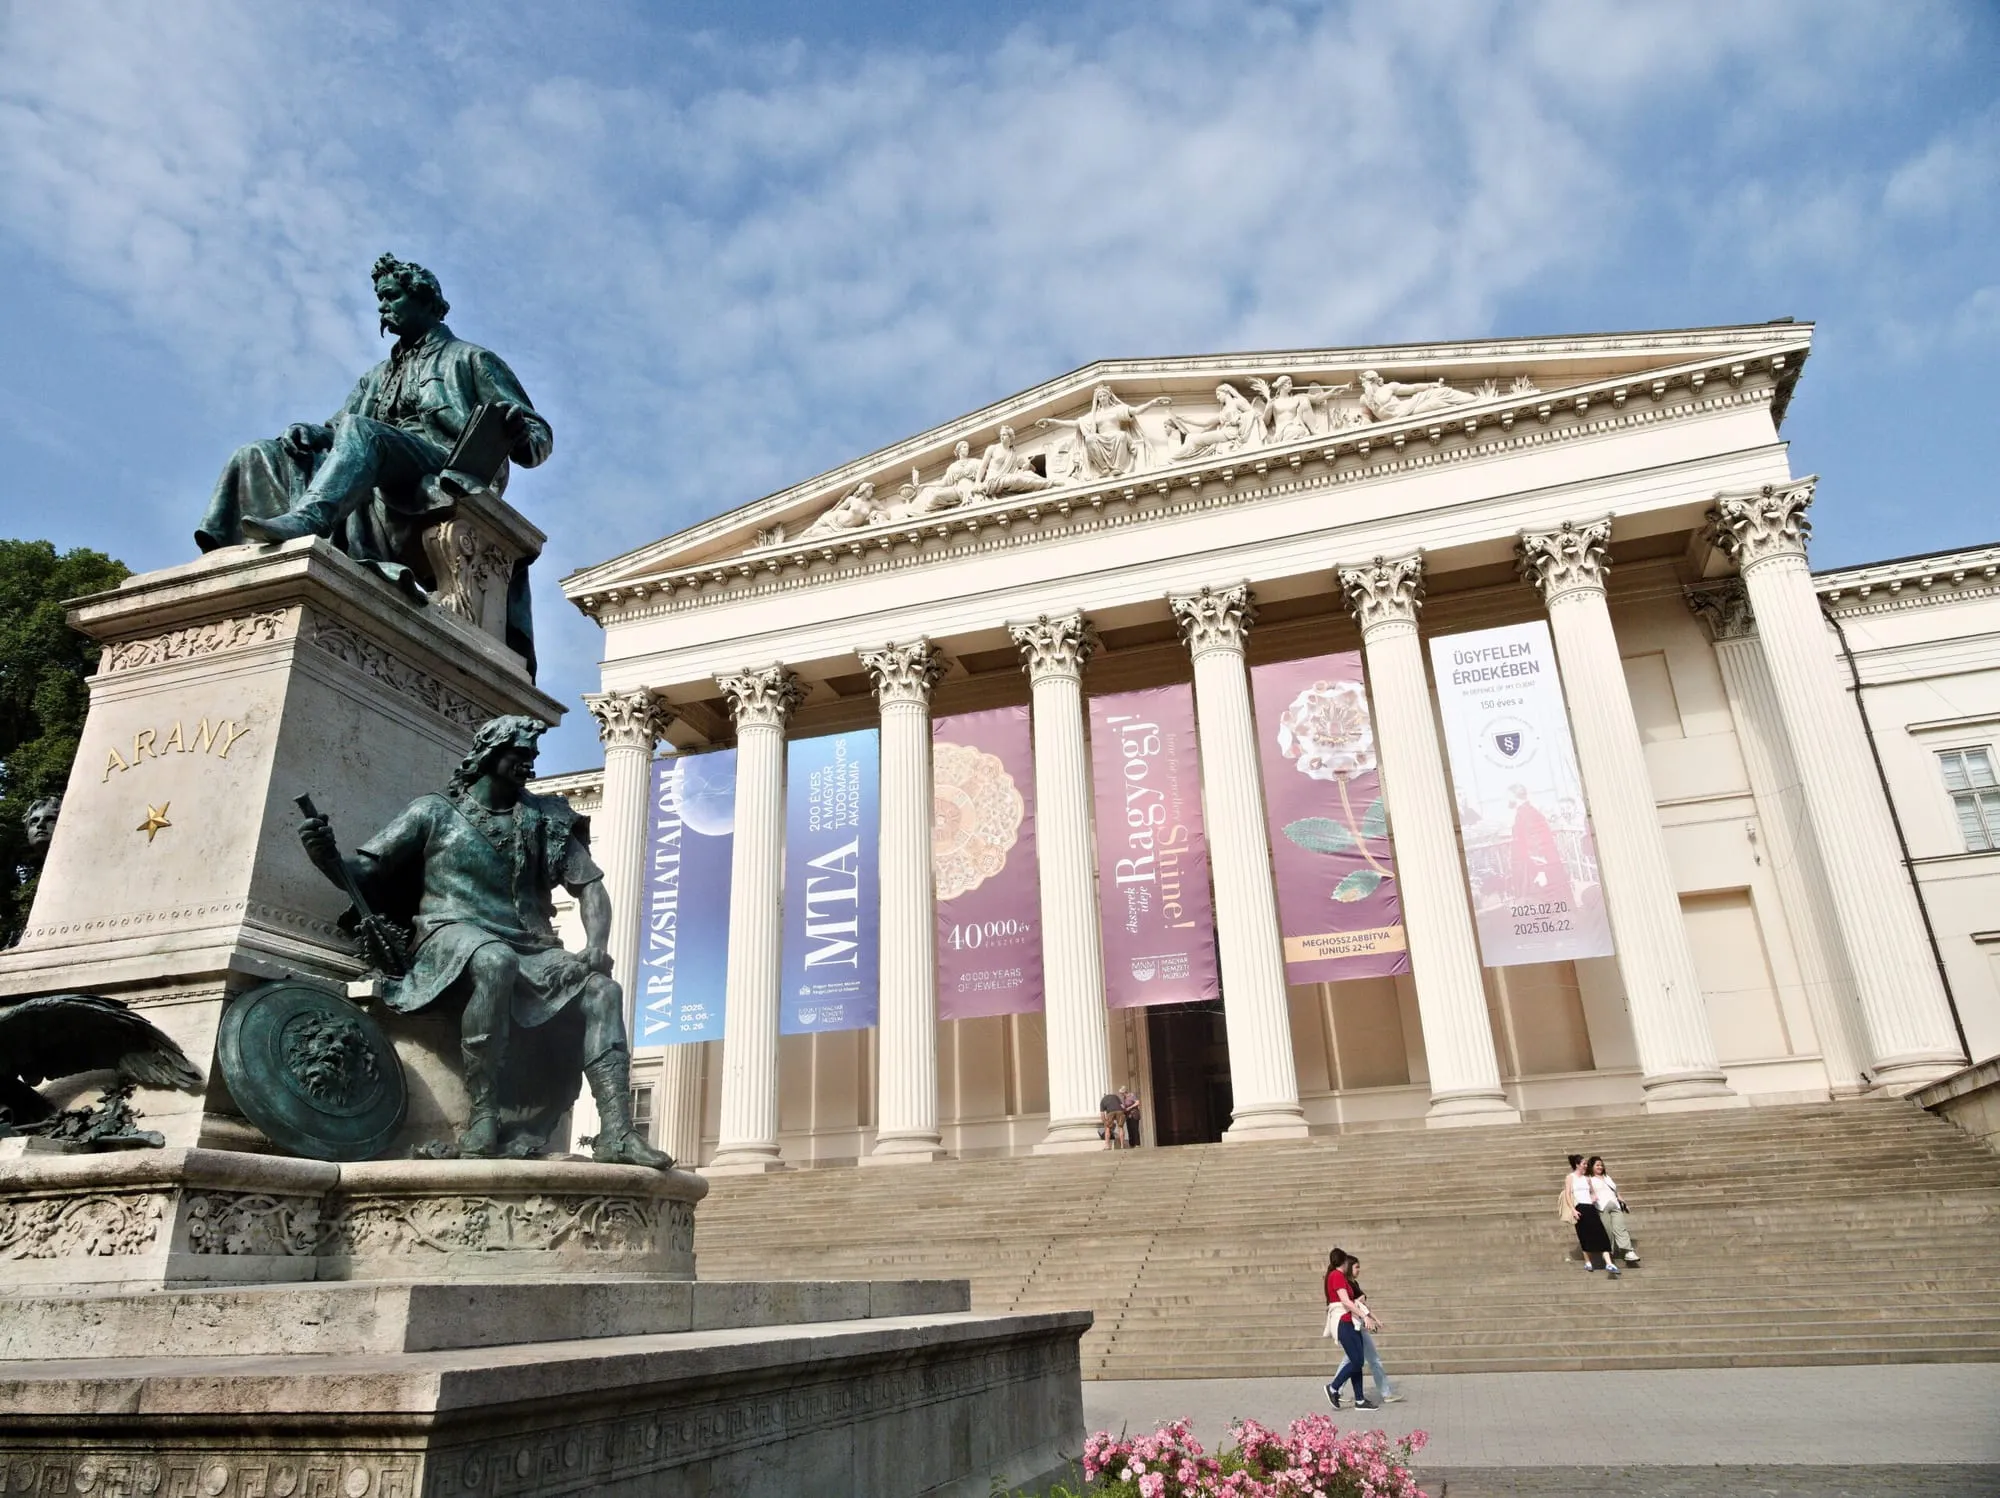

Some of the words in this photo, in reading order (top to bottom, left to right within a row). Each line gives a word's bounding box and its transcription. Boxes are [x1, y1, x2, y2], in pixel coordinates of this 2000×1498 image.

[1453, 642, 1532, 666] ÜGYFELEM
[1452, 660, 1540, 685] ÉRDEKÉBEN
[1480, 700, 1495, 710] 150
[102, 717, 250, 783] ARANY
[823, 765, 834, 818] MAGYAR
[1107, 714, 1167, 889] Ragyogj!
[809, 806, 821, 832] 200
[823, 820, 834, 830] A
[1157, 824, 1195, 929] Shine!
[643, 767, 685, 1037] VARÁZSHATALOM
[804, 834, 859, 972] MTA
[1511, 901, 1571, 917] 2025.02.20.
[1514, 919, 1574, 935] 2025.06.22.
